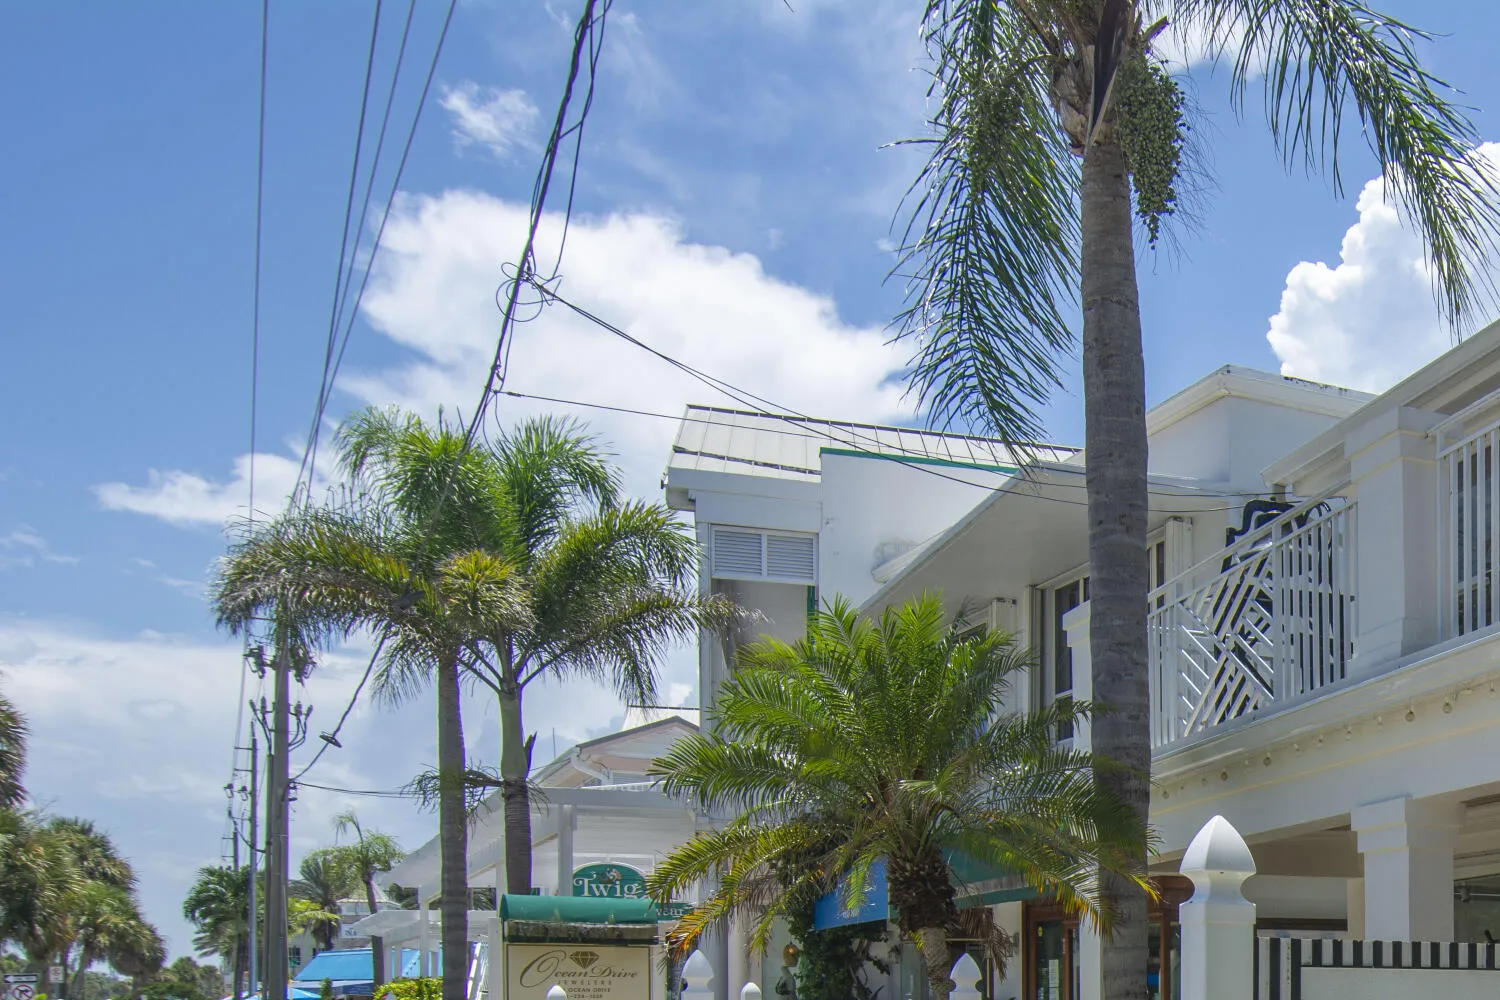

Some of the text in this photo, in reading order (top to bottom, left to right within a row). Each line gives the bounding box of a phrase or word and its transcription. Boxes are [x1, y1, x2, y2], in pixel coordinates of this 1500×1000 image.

[573, 871, 641, 899] Twig
[519, 949, 638, 989] Ocean Drive
